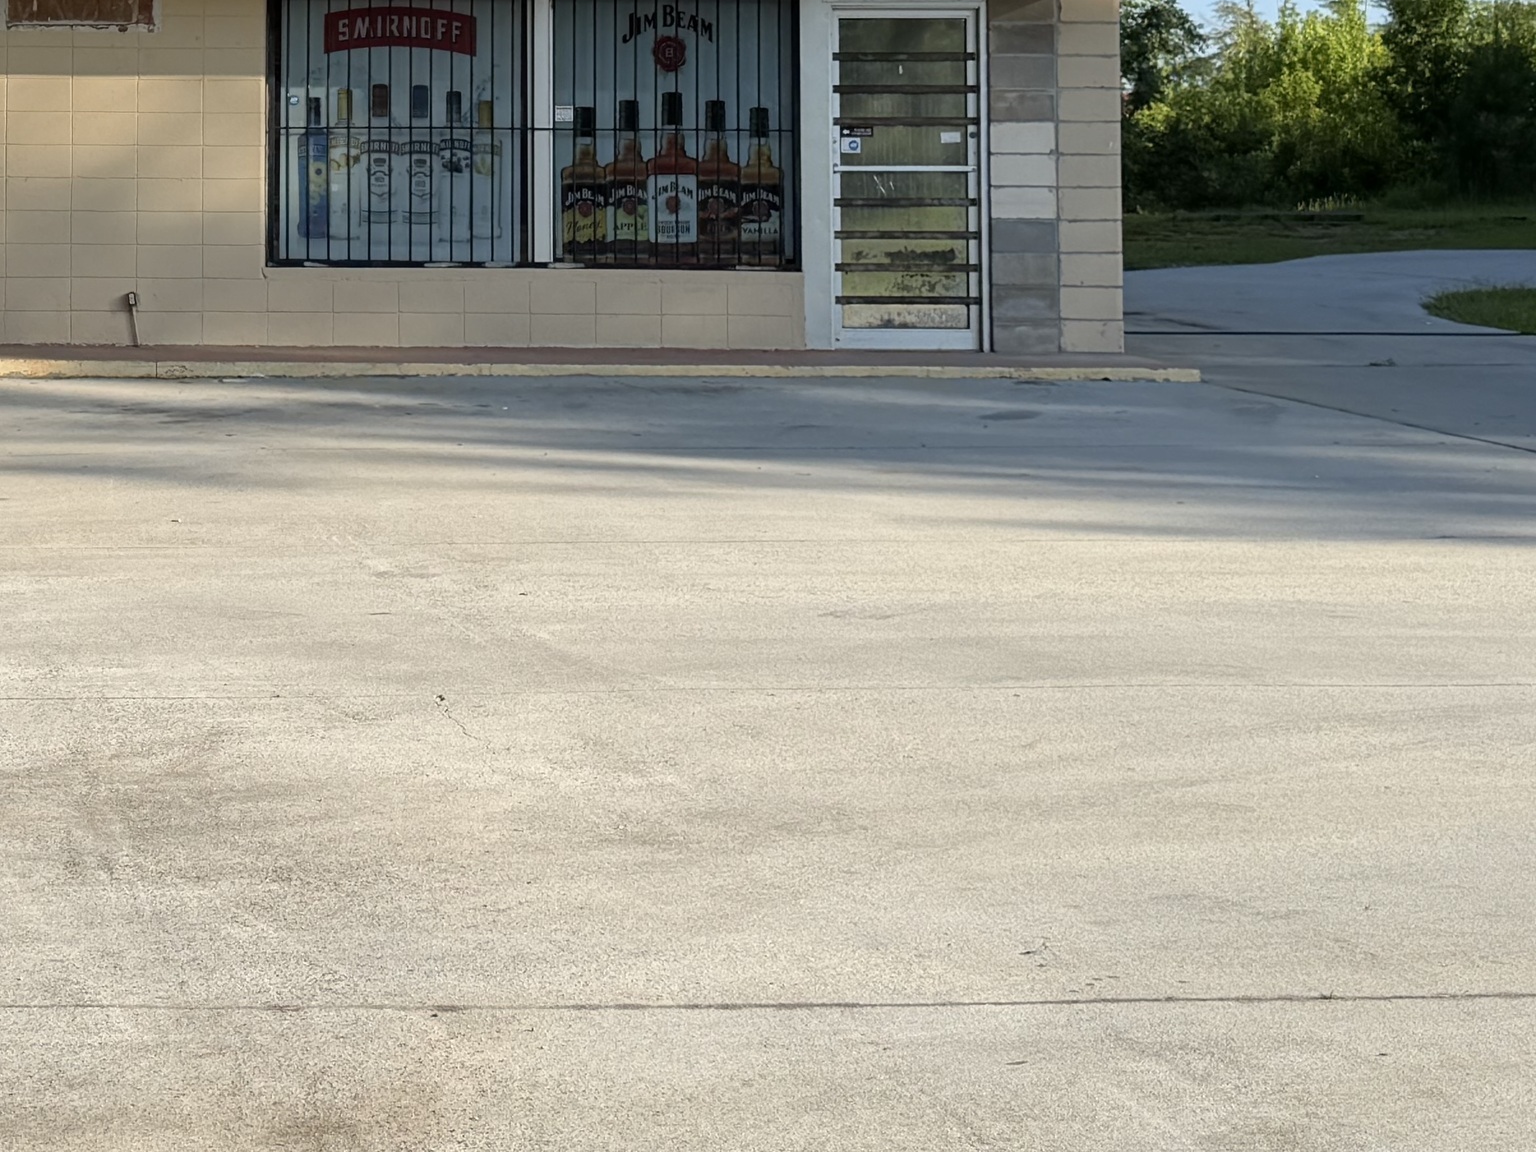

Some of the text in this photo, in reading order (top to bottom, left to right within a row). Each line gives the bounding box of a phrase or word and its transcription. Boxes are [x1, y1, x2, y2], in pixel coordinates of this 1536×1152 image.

[338, 15, 462, 43] SMIRNOFF
[622, 4, 713, 44] JIM BEAM
